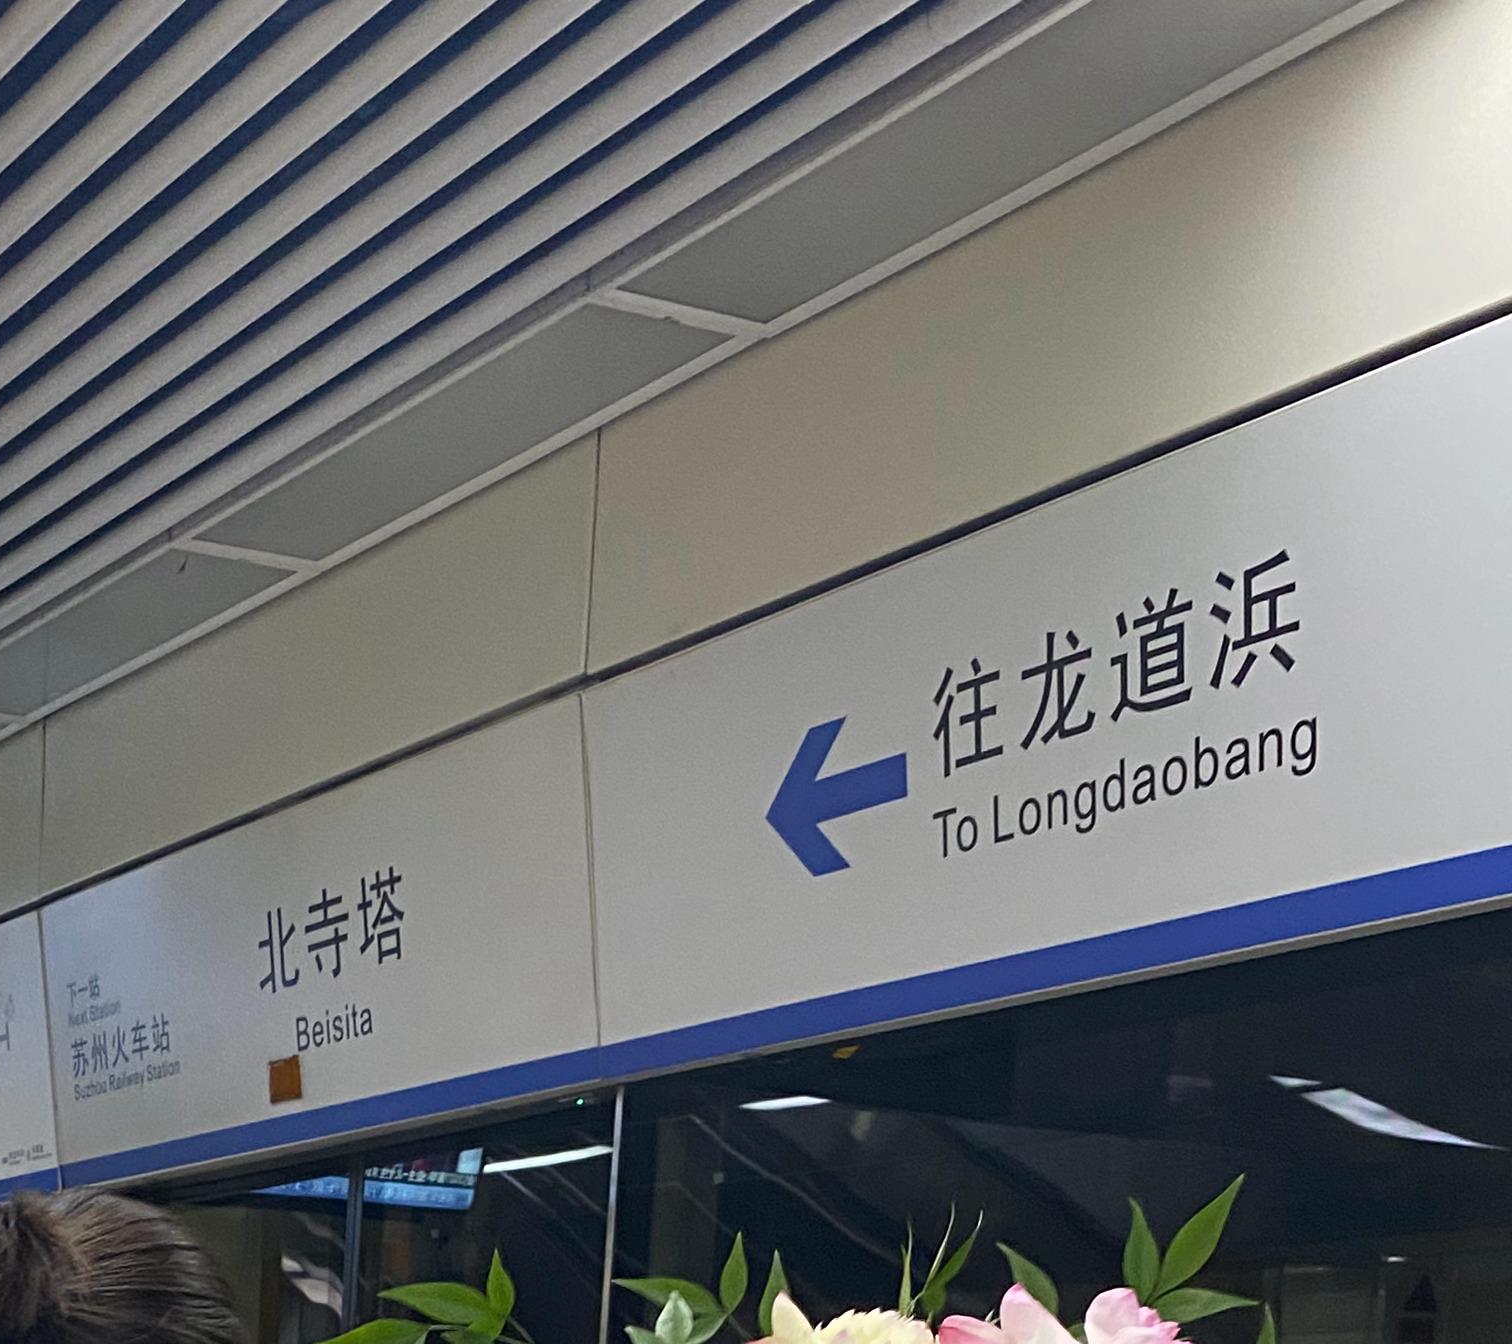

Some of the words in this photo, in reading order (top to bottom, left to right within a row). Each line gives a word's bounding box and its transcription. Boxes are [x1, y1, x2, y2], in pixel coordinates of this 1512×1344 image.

[932, 549, 1301, 778] 往龙道浜
[932, 806, 979, 858] To
[992, 715, 1319, 844] Longdaobang
[258, 865, 405, 994] 北寺塔
[66, 973, 101, 1007] 下一站
[70, 1011, 170, 1079] 苏州火车站
[295, 1003, 373, 1052] Beisita
[74, 1080, 108, 1101] Suzhou
[109, 1067, 145, 1091] Railway
[146, 1059, 181, 1082] Station
